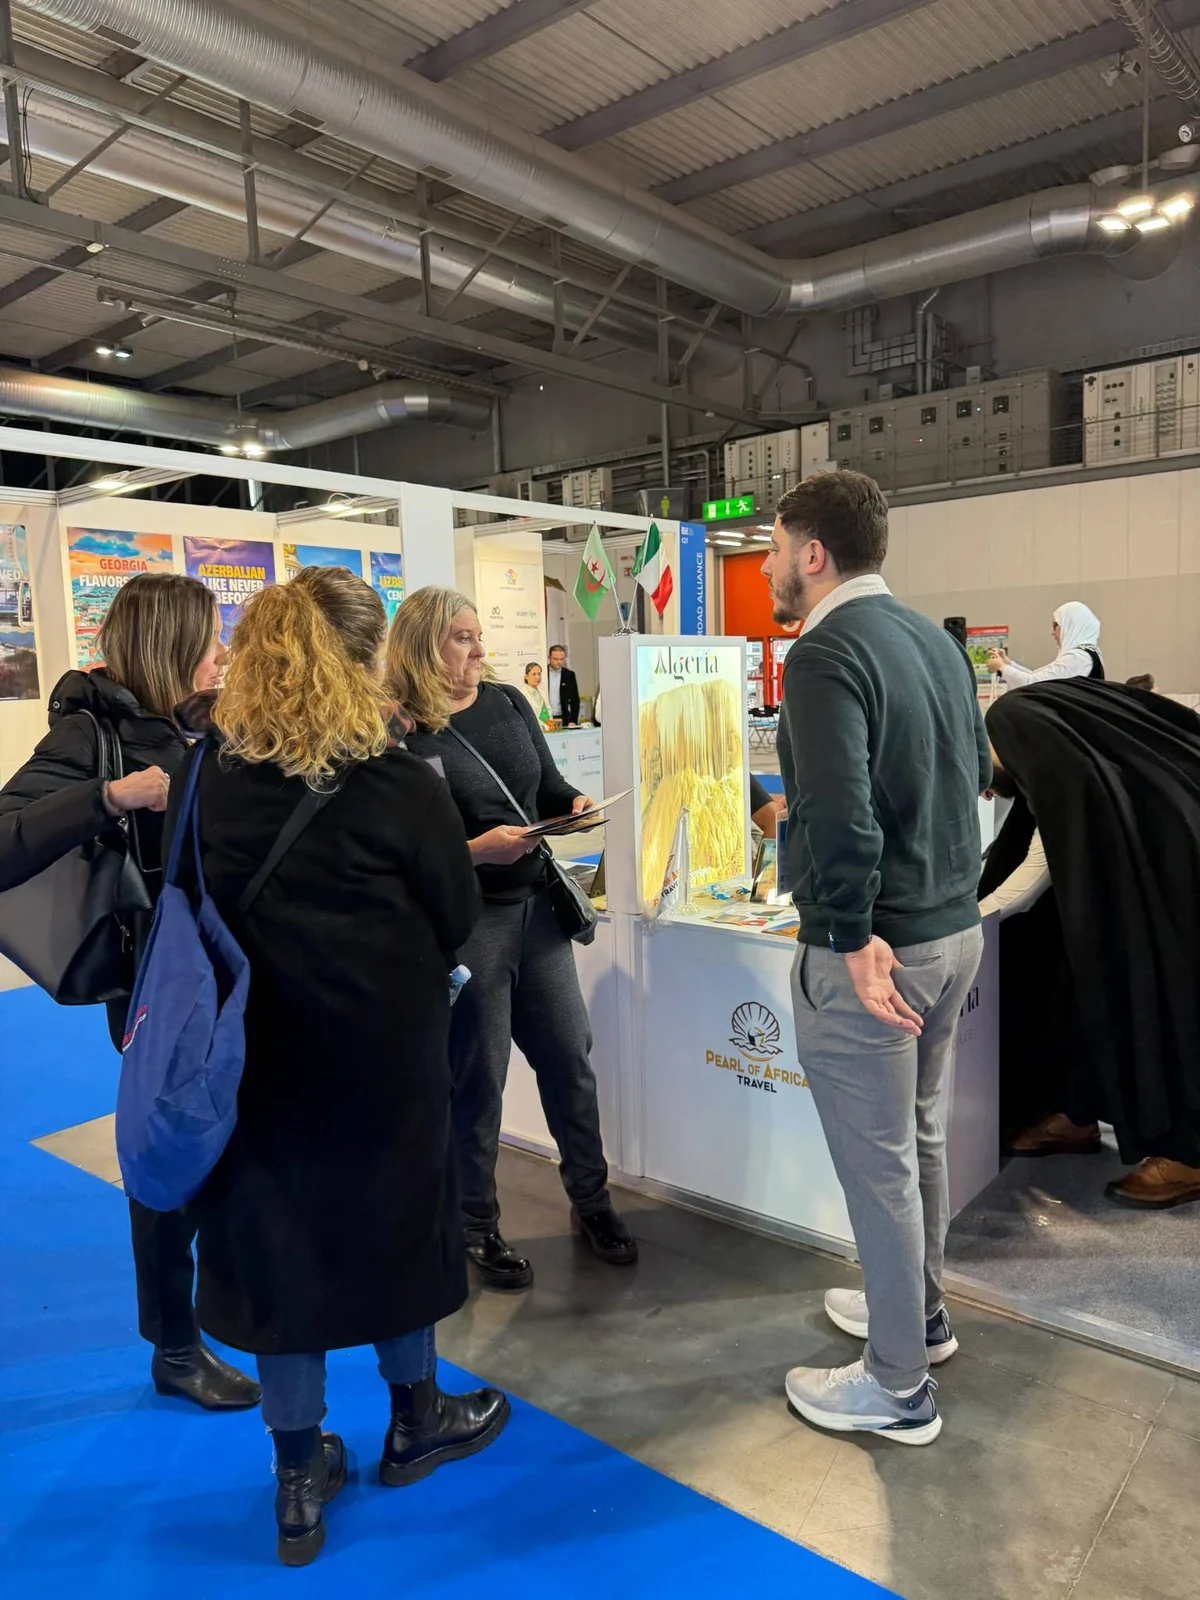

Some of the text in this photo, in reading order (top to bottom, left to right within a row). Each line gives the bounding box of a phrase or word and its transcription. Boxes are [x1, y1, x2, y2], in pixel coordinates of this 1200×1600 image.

[100, 558, 148, 571] GEORGIA
[198, 563, 265, 580] AZERBAIJAN
[203, 577, 264, 593] LIKE NEVER
[696, 552, 704, 604] ALLIANCE
[654, 646, 718, 684] Algeria
[706, 1049, 810, 1089] PEARL OF AFRICA
[736, 1074, 778, 1094] TRAVEL
